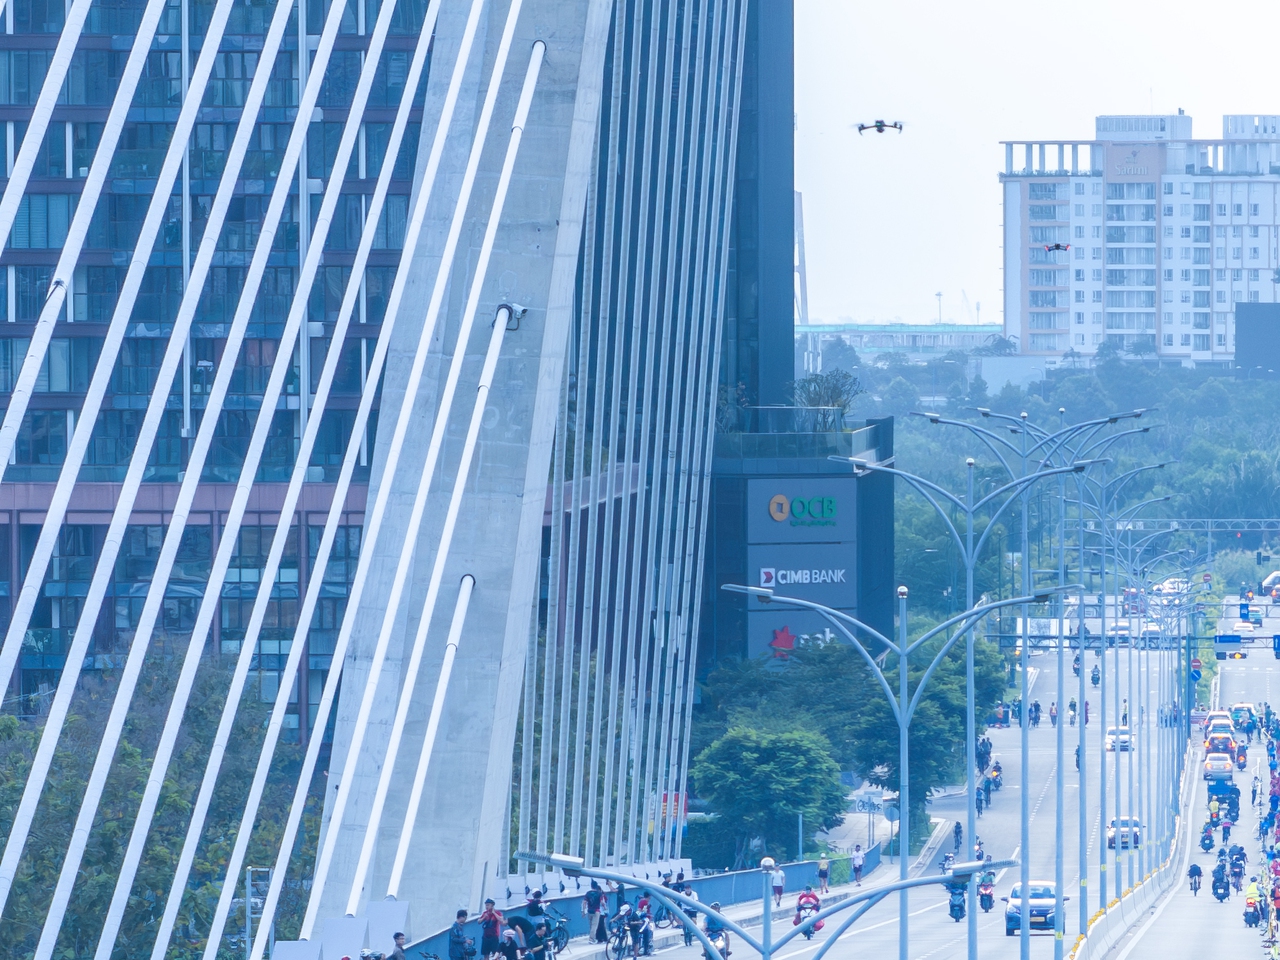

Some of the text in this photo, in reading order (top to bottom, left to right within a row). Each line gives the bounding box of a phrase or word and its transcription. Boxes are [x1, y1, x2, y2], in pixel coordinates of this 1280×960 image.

[790, 496, 837, 519] OCB
[777, 569, 846, 585] CIMB BANK
